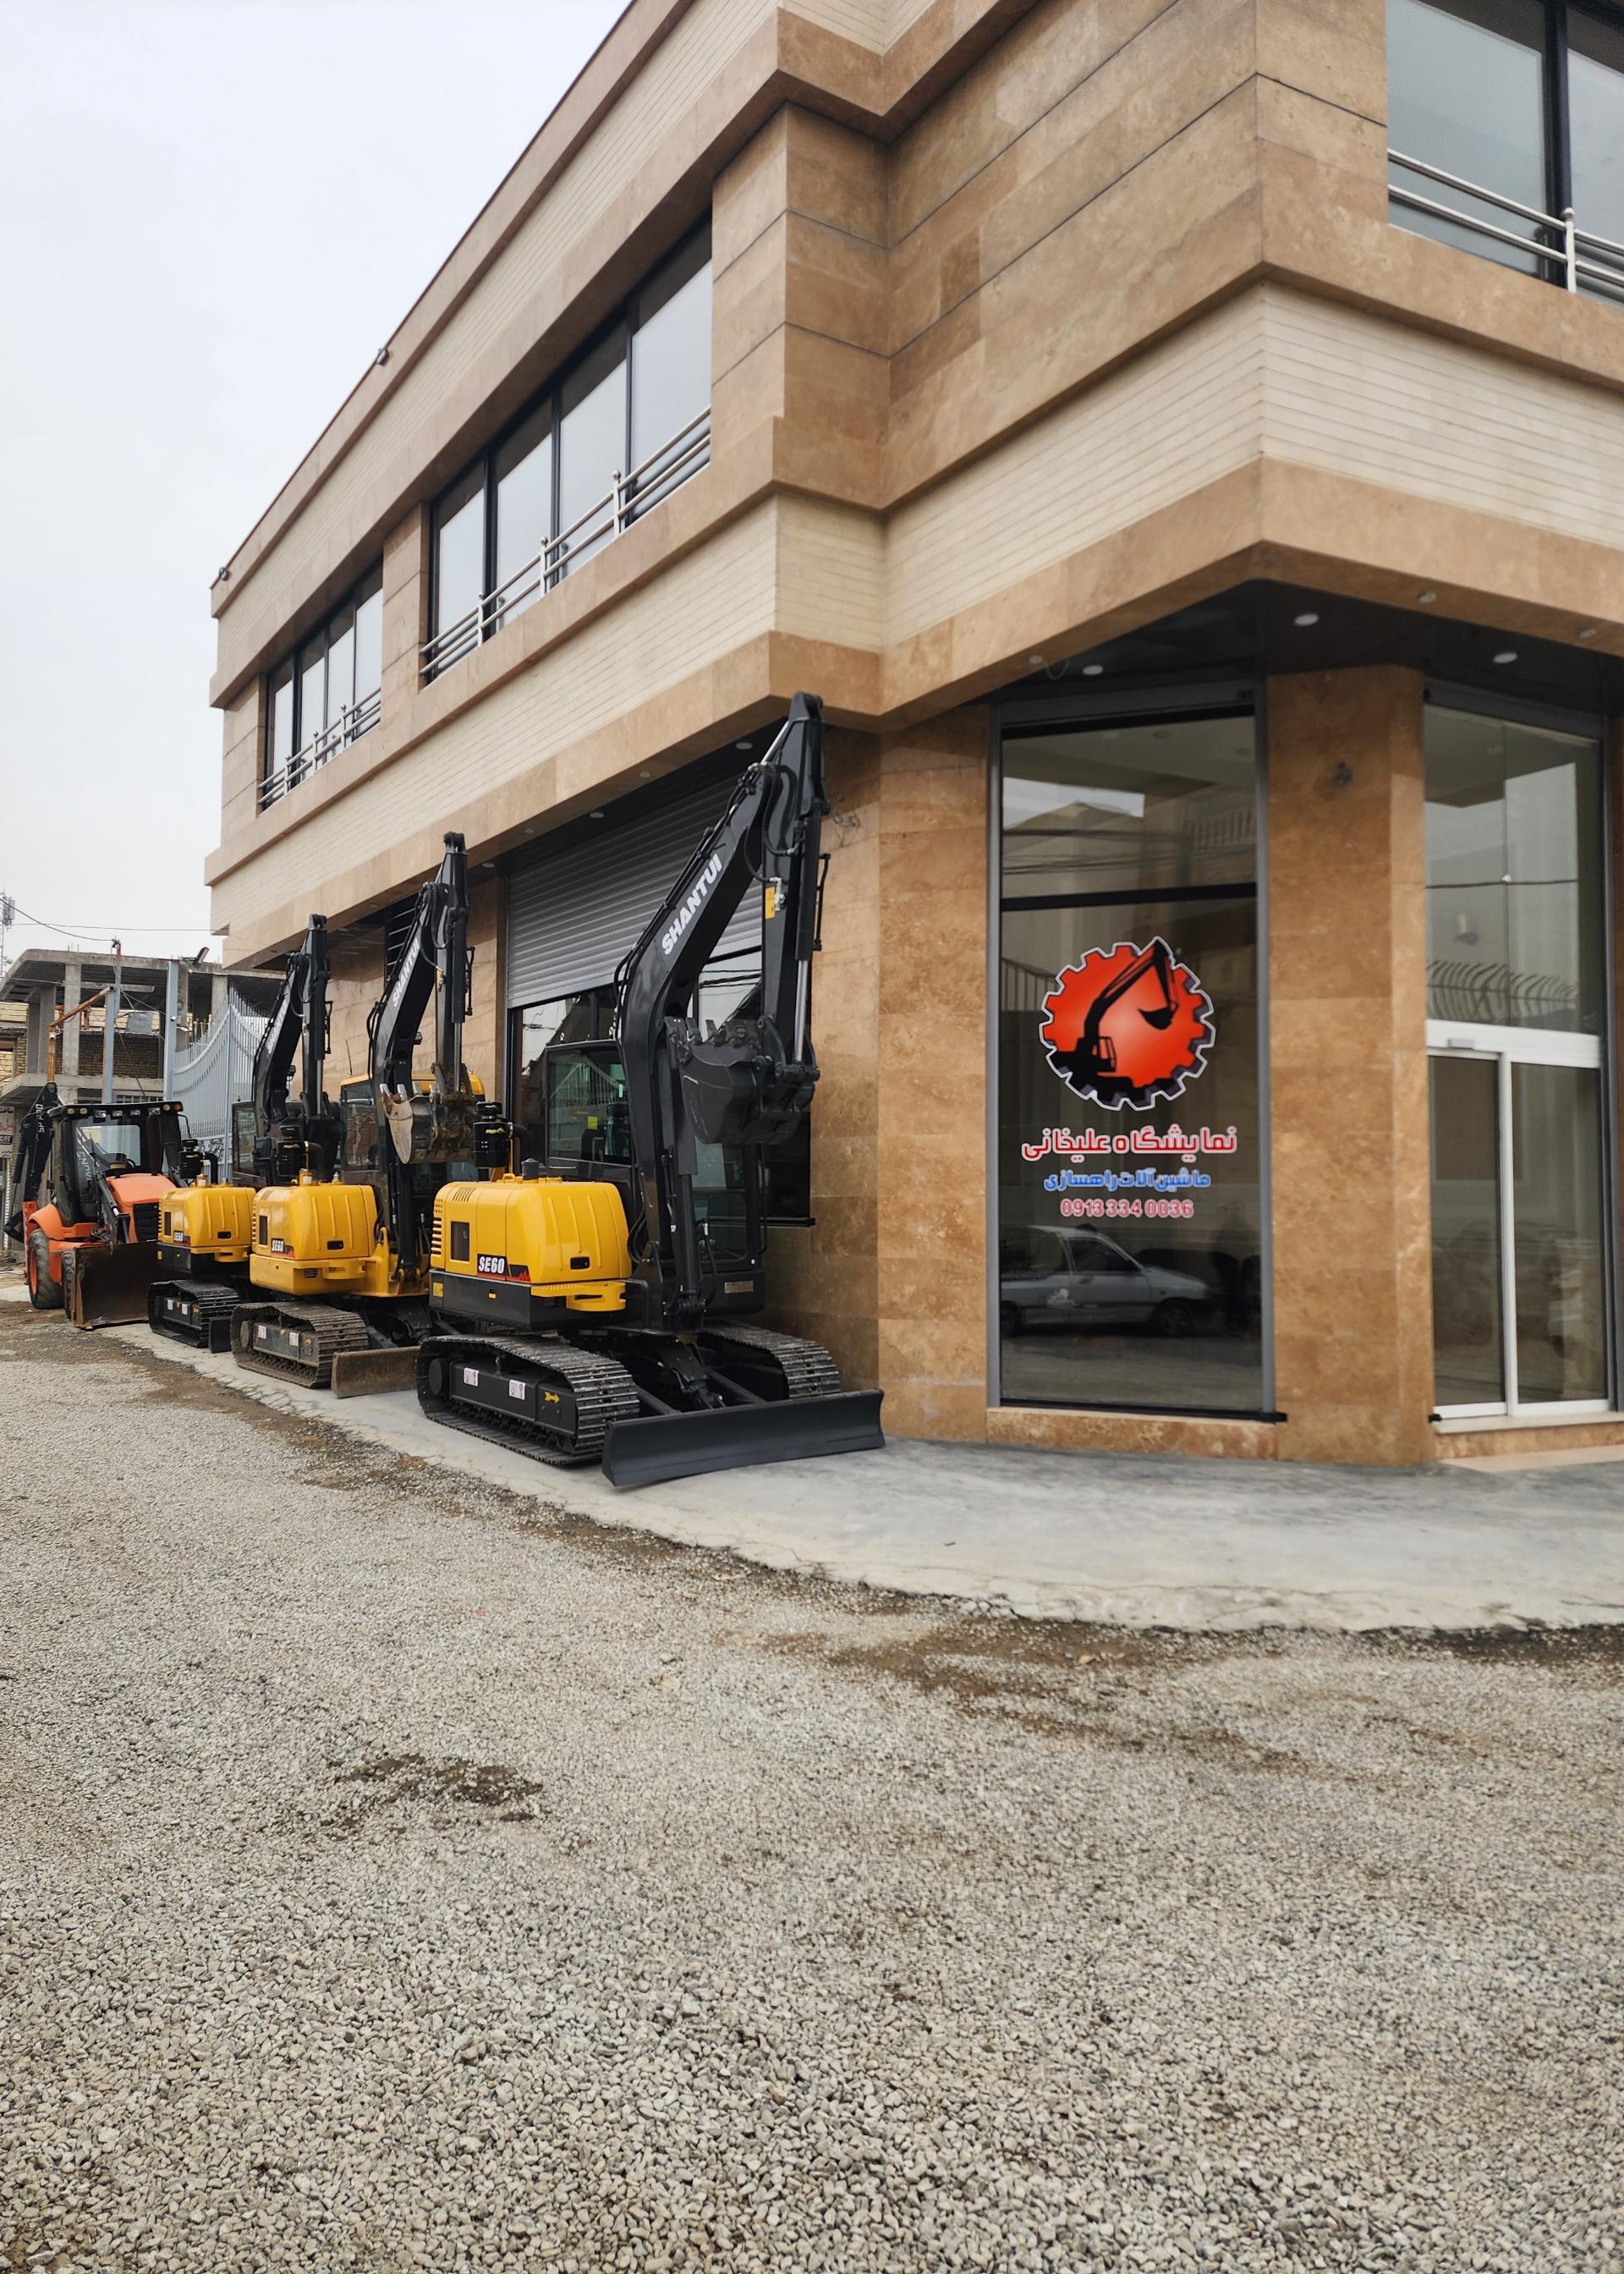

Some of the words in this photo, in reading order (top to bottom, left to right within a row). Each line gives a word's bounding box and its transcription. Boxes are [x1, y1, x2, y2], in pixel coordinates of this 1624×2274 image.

[661, 853, 722, 955] SHANTUI
[392, 937, 420, 1008] SHANTUI
[1022, 1128, 1111, 1163] علیخانی
[1112, 1123, 1237, 1162] نمایشگاه
[1155, 1167, 1211, 1192] ماشین
[1060, 1198, 1105, 1217] 0913
[1105, 1198, 1143, 1218] 334
[1144, 1199, 1194, 1218] 0036
[478, 1255, 505, 1274] SE60
